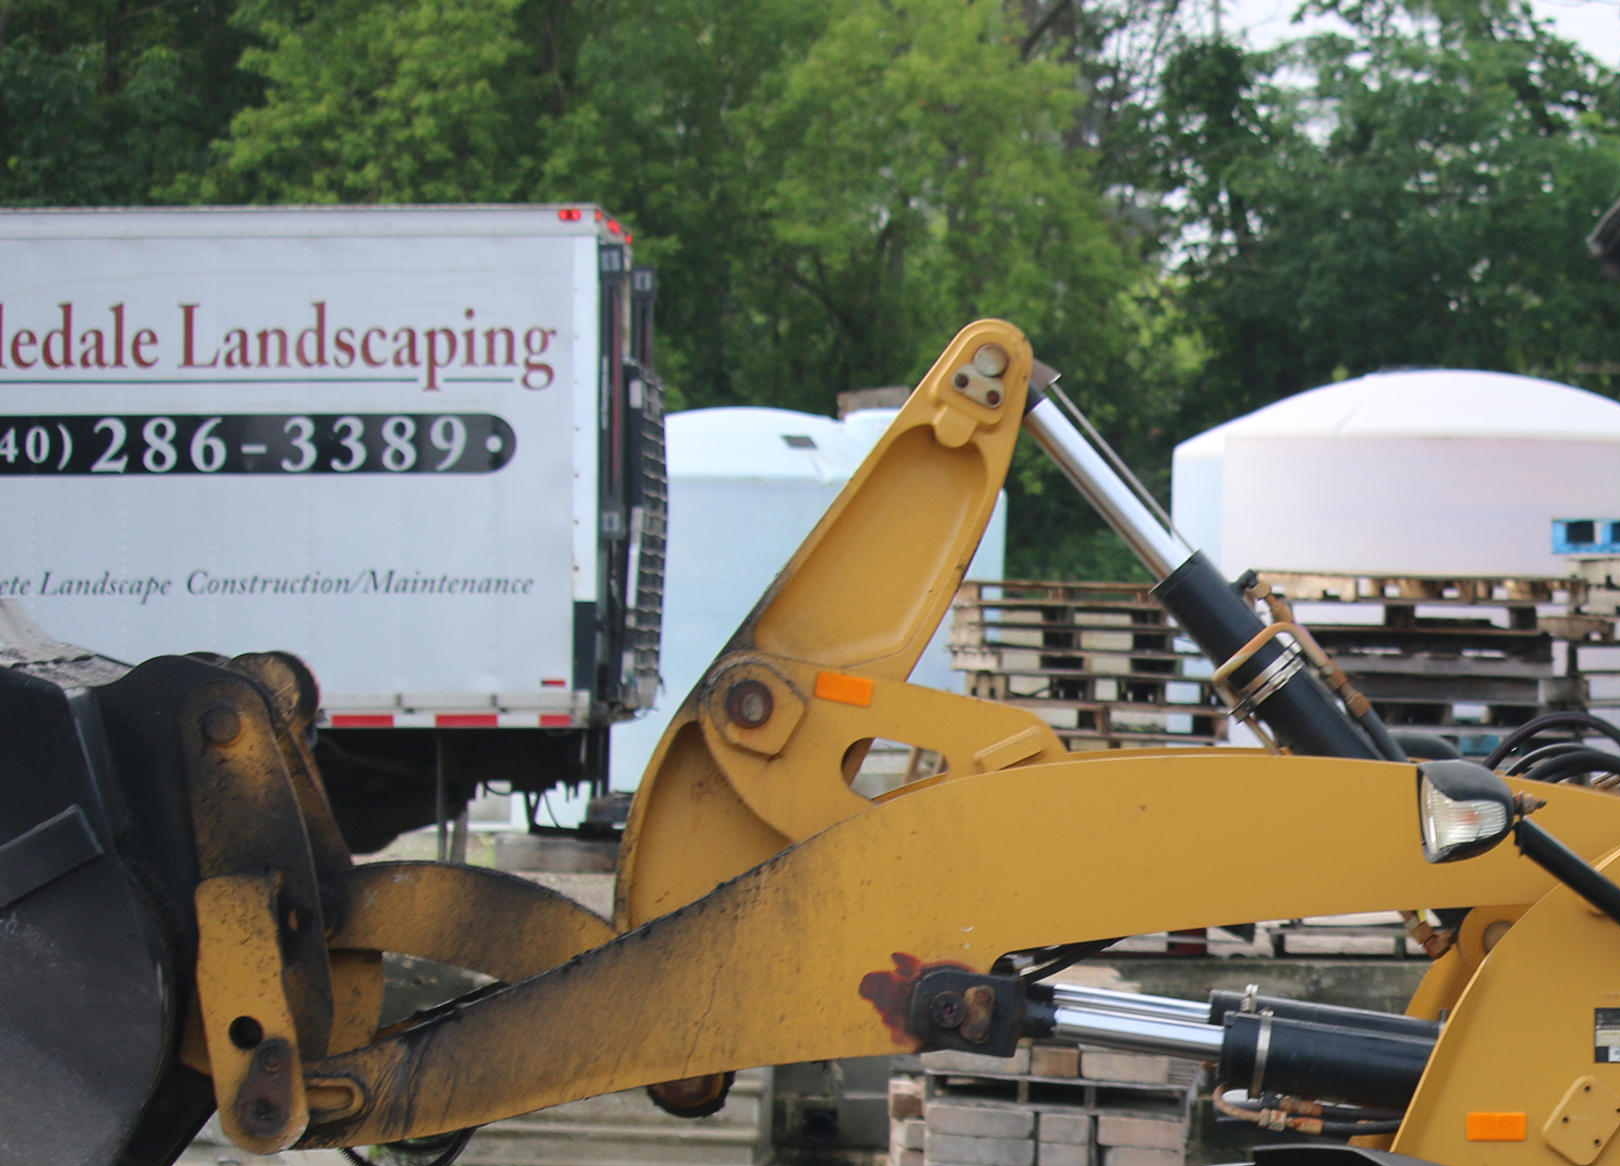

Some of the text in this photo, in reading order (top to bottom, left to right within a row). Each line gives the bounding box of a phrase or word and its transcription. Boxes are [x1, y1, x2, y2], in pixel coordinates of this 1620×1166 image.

[178, 301, 557, 391] Landscaping
[91, 415, 467, 474] 286-3389
[40, 570, 172, 605] Landscape
[186, 569, 534, 596] Construction/Maintenance
